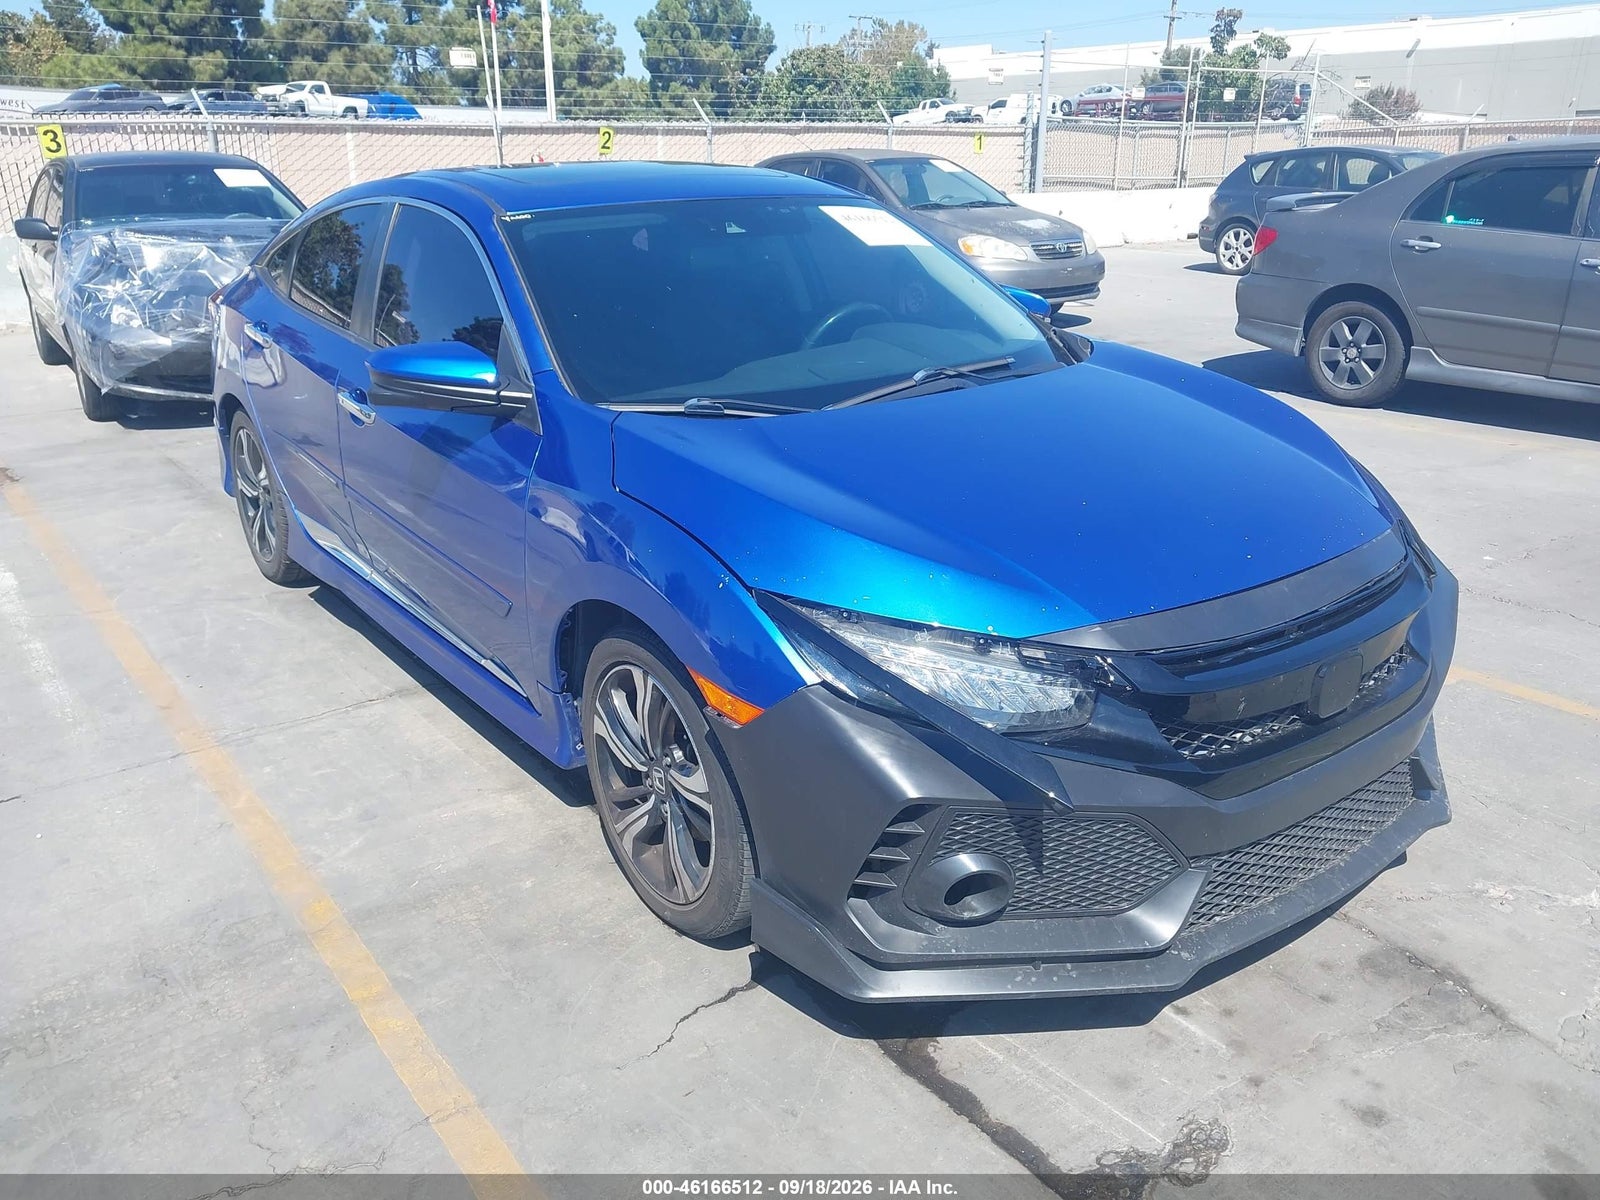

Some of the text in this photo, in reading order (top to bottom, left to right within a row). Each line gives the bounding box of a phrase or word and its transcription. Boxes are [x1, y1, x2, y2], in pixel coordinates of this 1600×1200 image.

[42, 129, 62, 153] 3
[601, 131, 611, 150] 2
[977, 134, 983, 150] 1
